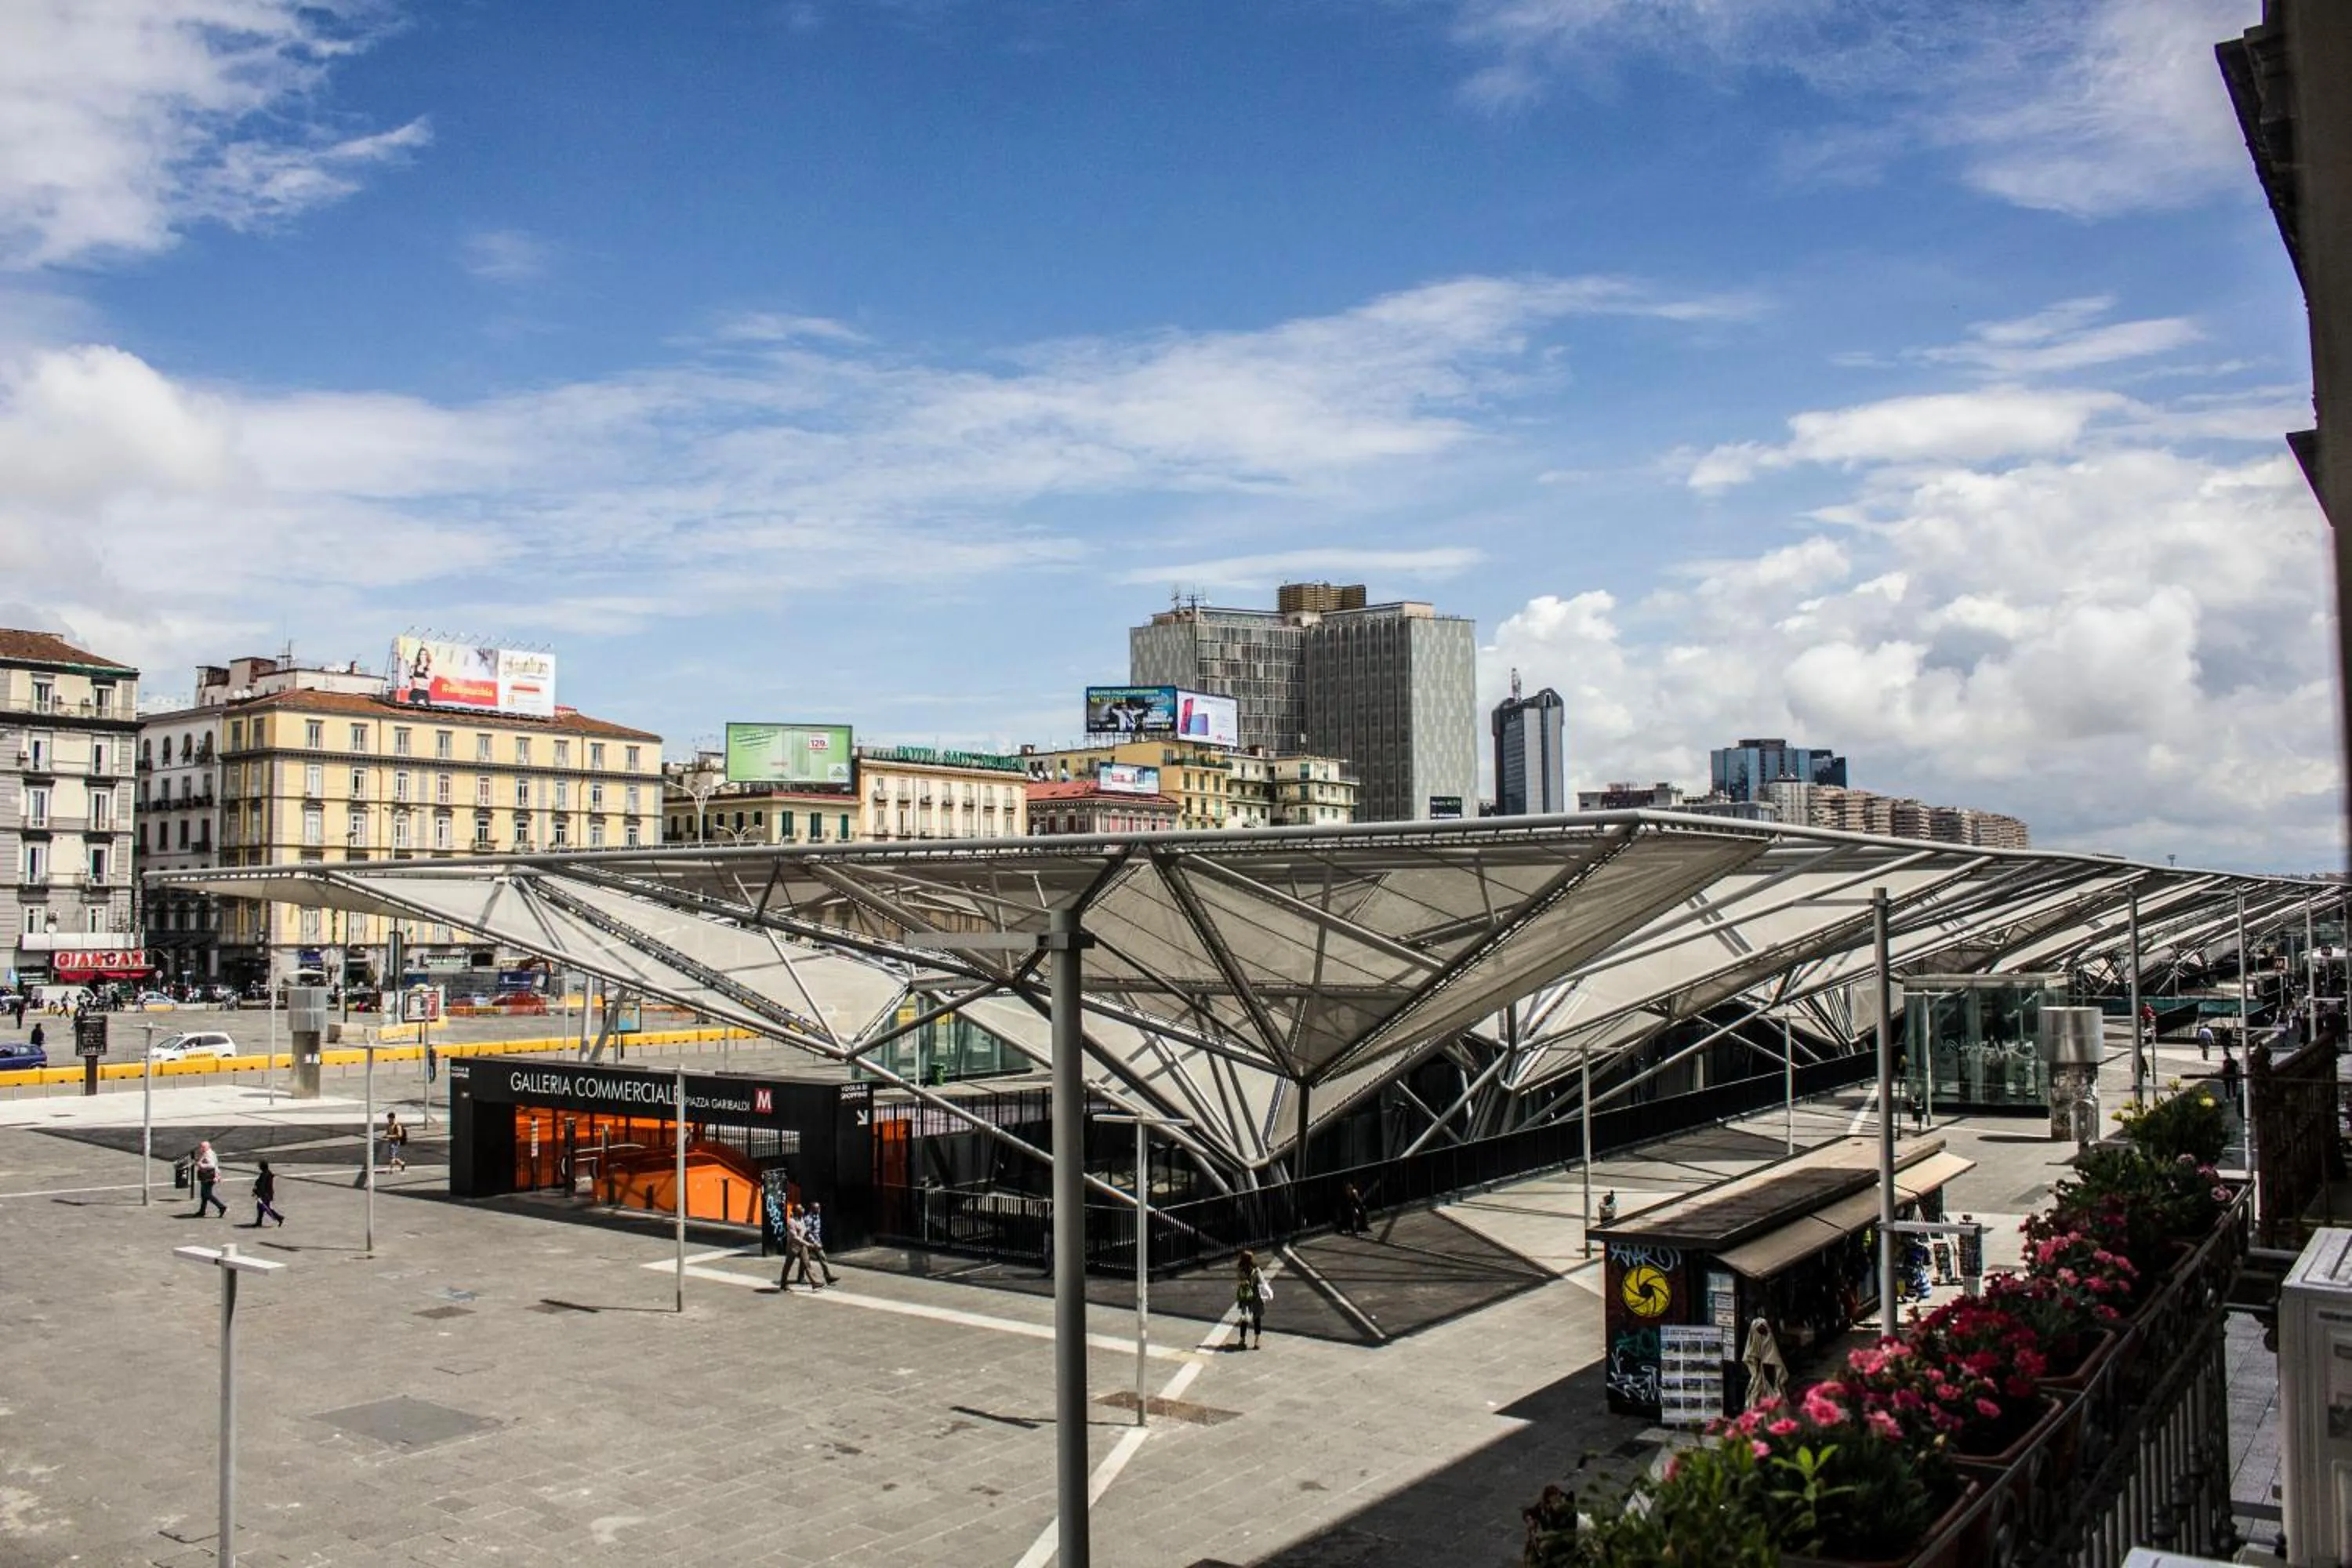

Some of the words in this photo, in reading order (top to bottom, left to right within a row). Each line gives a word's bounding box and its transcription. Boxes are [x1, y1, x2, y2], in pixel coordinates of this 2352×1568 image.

[510, 1072, 572, 1096] GALLERIA
[575, 1076, 678, 1105] COMMERCIALE
[757, 1091, 771, 1109] M
